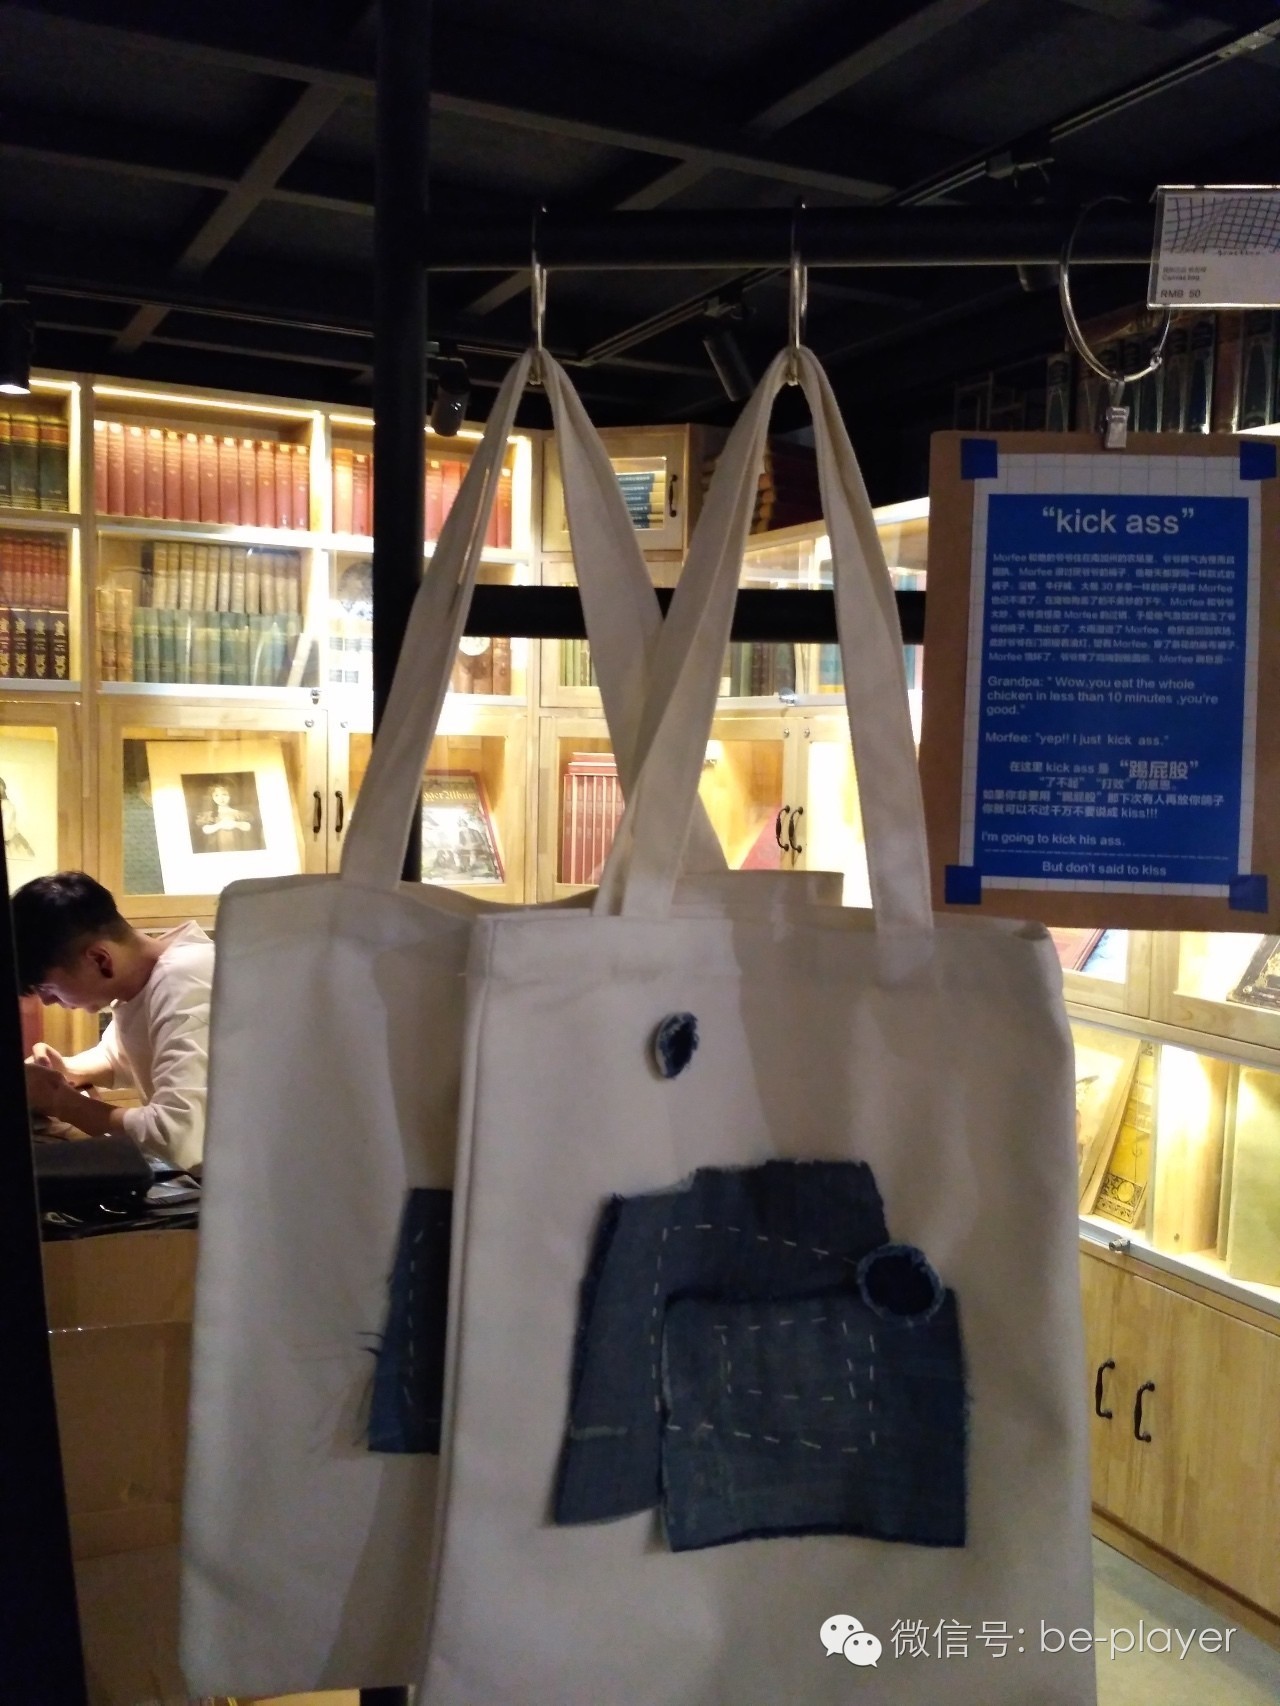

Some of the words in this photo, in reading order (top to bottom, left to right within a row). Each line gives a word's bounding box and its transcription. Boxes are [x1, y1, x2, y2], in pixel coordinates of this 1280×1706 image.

[1161, 289, 1184, 298] RMB
[1189, 289, 1201, 298] 50
[988, 676, 1044, 688] Grandpa:
[1114, 679, 1134, 688] eat
[1136, 678, 1155, 688] the
[1158, 679, 1196, 690] whole
[987, 690, 1032, 701] chicken
[1036, 691, 1046, 701] in
[1050, 692, 1074, 702] less
[1078, 692, 1104, 702] than
[1108, 692, 1122, 702] 10
[1124, 692, 1173, 704] minutes
[986, 732, 1032, 744] Morfee:
[1079, 734, 1102, 746] just
[1107, 734, 1132, 745] kick
[1046, 762, 1070, 773] kick
[1074, 764, 1094, 774] ass
[982, 831, 998, 842] I'm
[1001, 832, 1034, 845] going
[1038, 834, 1050, 844] to
[1052, 834, 1076, 844] kick
[1079, 834, 1097, 845] his
[1100, 836, 1126, 847] ass.
[1042, 860, 1063, 872] But
[1066, 862, 1096, 874] don't
[1098, 862, 1124, 874] said
[1127, 864, 1140, 875] to
[1142, 864, 1167, 876] kiss
